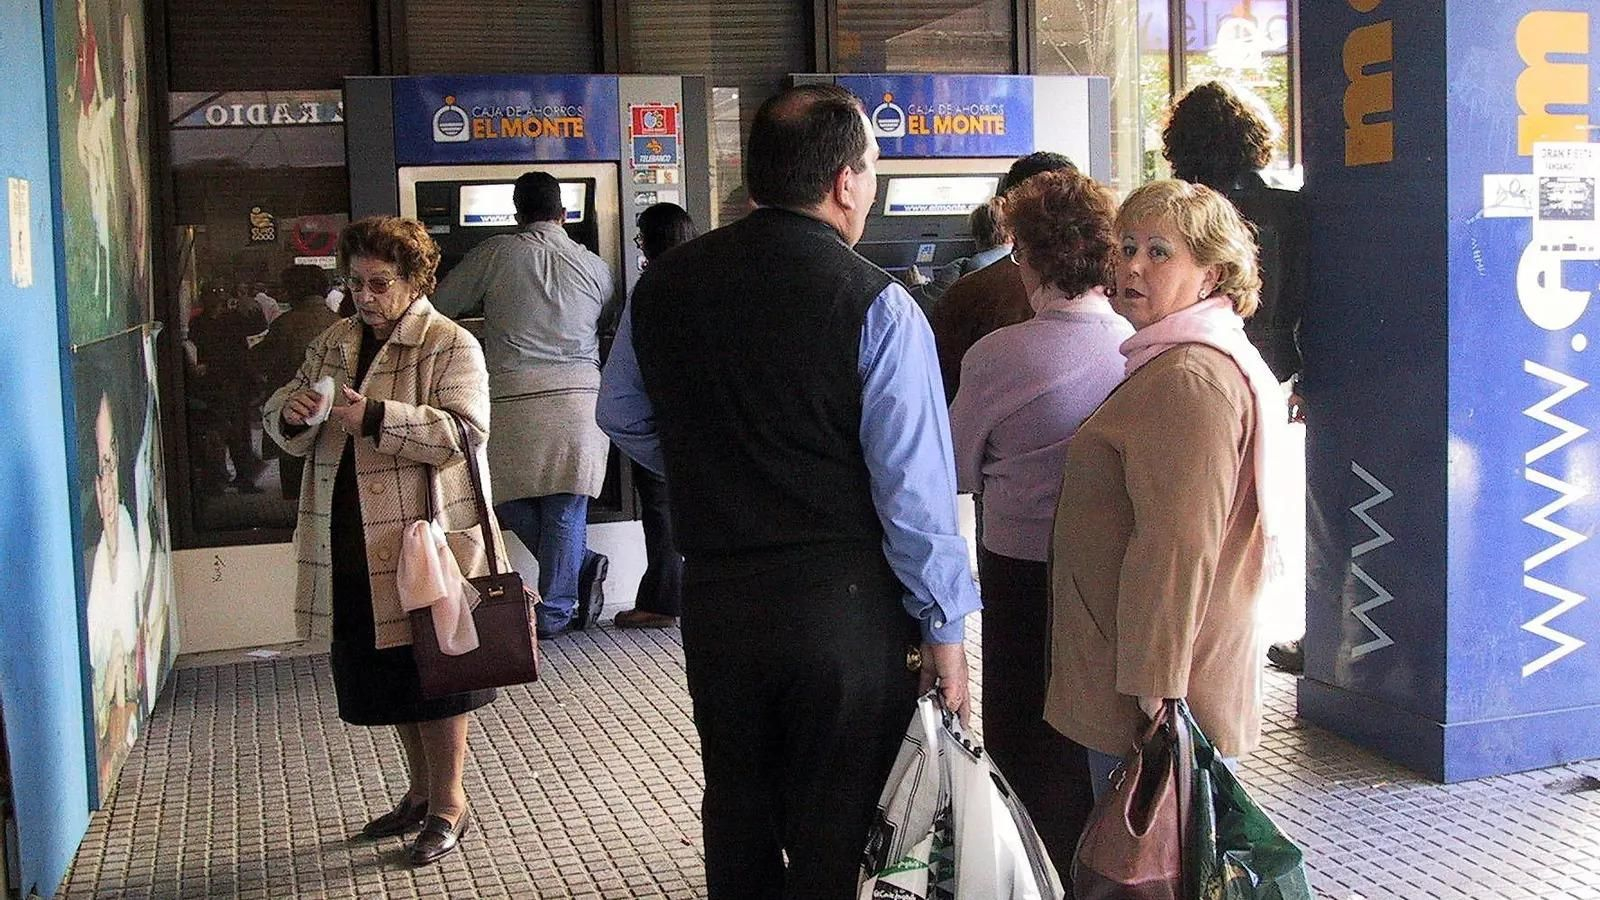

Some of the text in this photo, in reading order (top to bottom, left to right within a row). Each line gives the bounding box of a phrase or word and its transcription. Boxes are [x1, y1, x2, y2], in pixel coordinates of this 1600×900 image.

[472, 105, 584, 117] CAJA DE AHORROS
[908, 104, 1004, 115] CAJA DE AHORROS
[472, 116, 584, 138] EL MONTE
[908, 114, 1005, 135] EL MONTE
